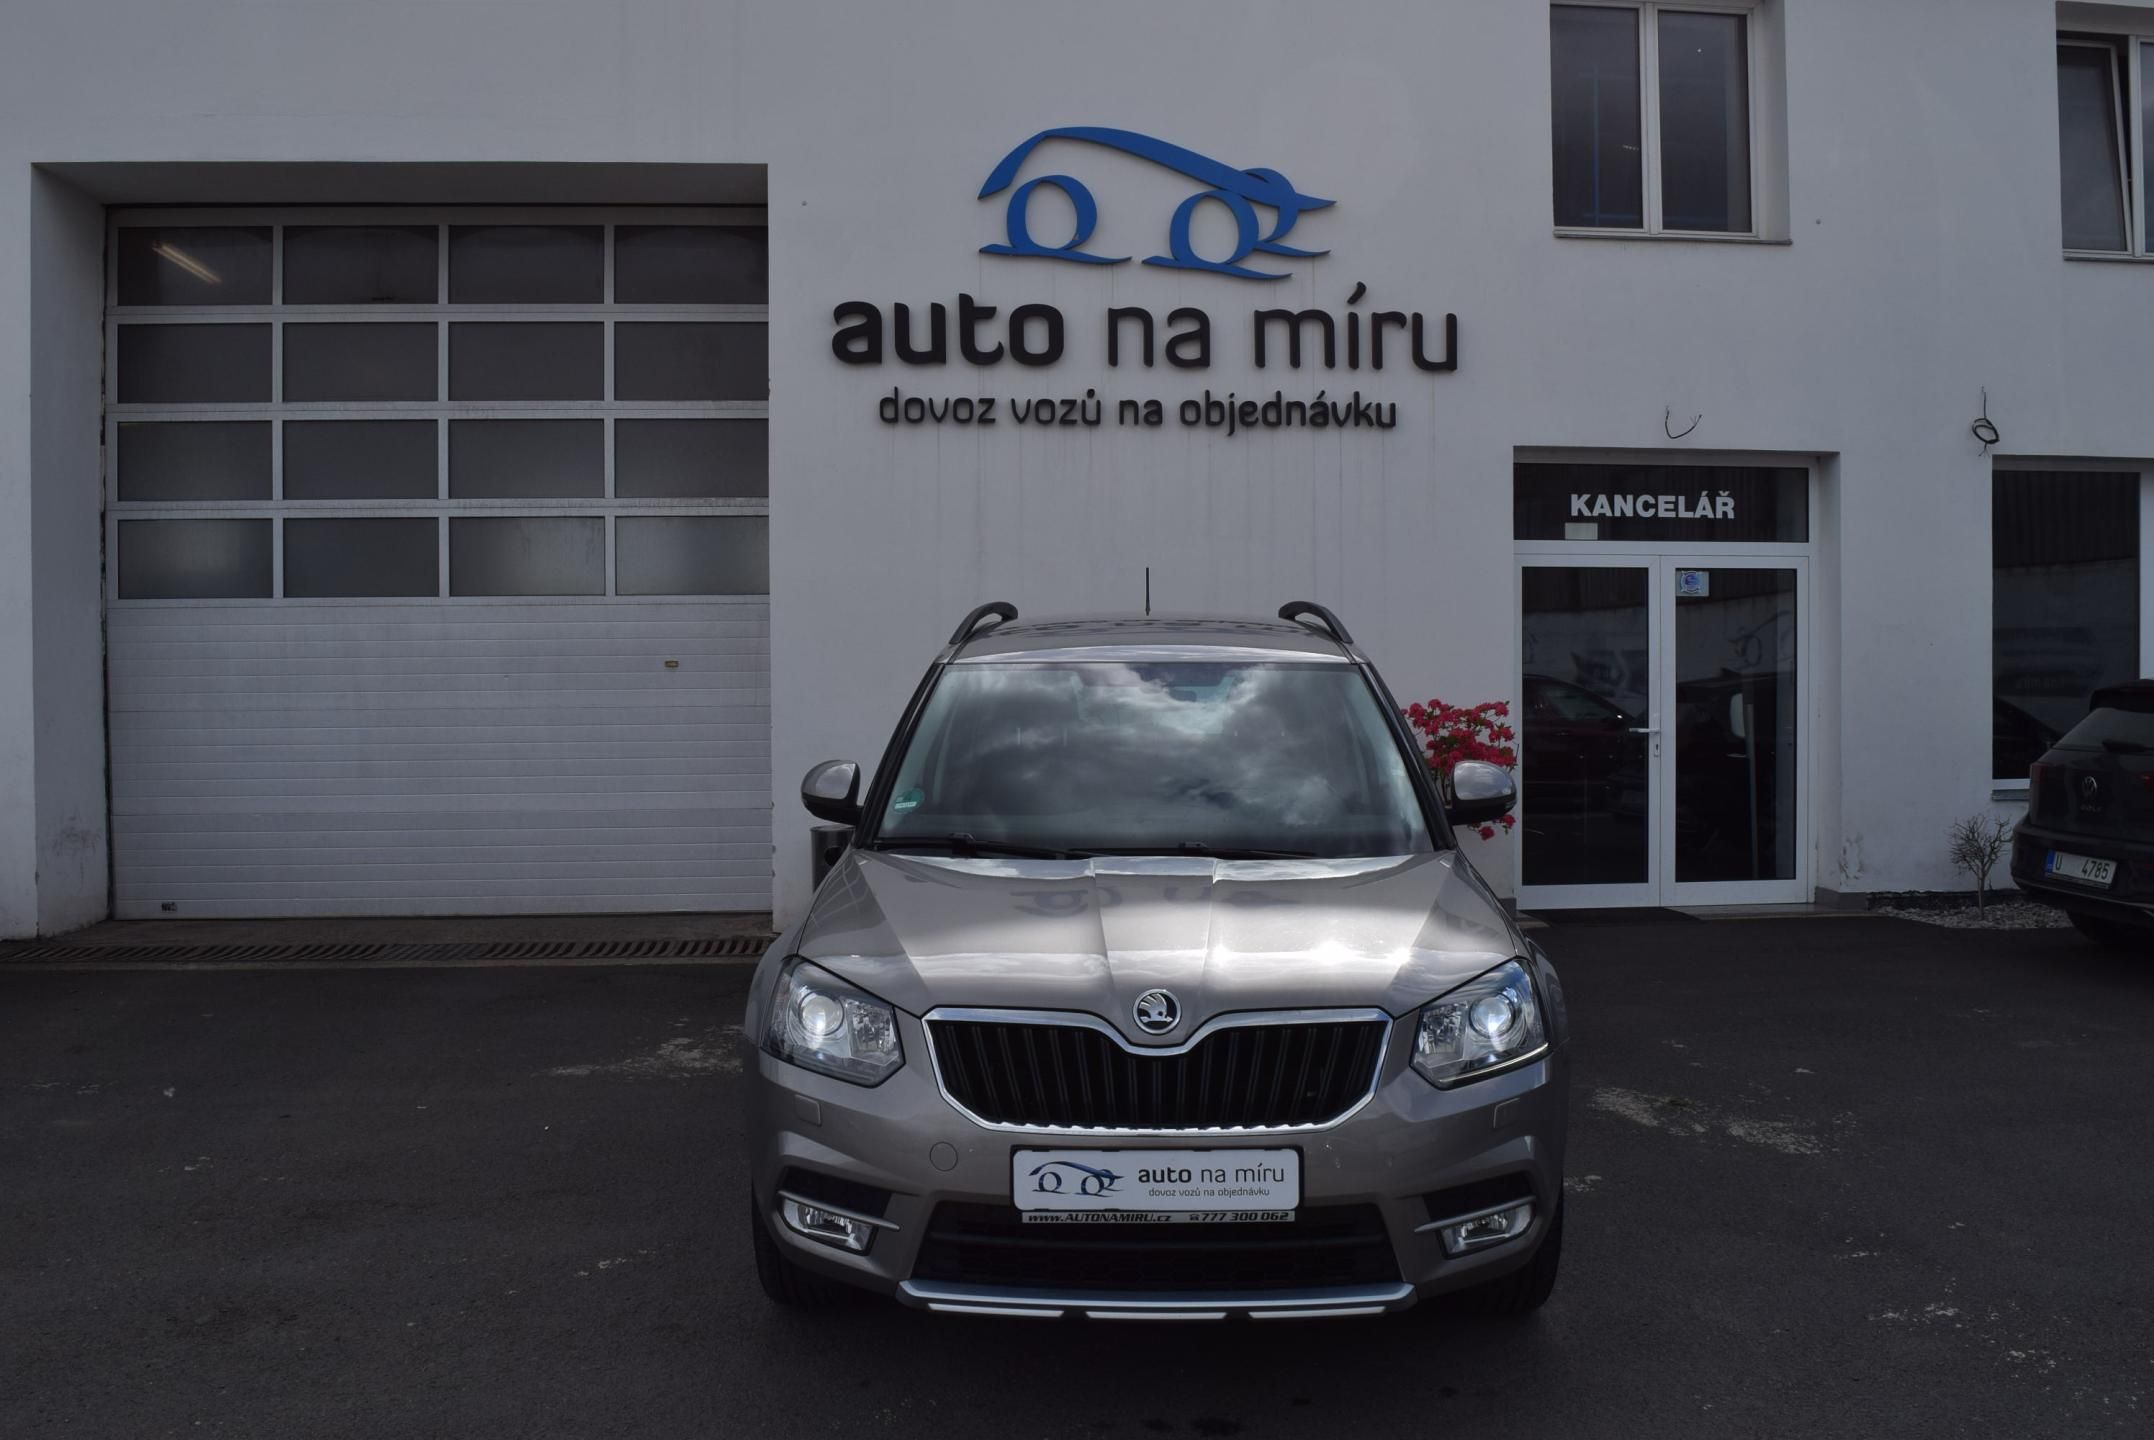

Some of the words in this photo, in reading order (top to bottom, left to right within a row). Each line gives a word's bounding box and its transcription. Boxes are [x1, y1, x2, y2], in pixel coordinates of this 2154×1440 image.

[832, 293, 1065, 368] auto
[1107, 306, 1211, 370] na
[1254, 281, 1458, 371] míru
[879, 387, 996, 426] dovoz
[1011, 388, 1101, 427] vozů
[1118, 399, 1163, 427] na
[1179, 389, 1397, 436] objednávku
[1570, 490, 1736, 519] KANCELÁŘ
[2082, 859, 2110, 880] 4785
[1138, 1166, 1192, 1183] auto
[1200, 1168, 1226, 1183] na
[1235, 1162, 1285, 1183] míru
[1148, 1187, 1177, 1197] dovoz
[1178, 1186, 1201, 1197] vozů
[1203, 1189, 1215, 1197] na
[1217, 1186, 1270, 1199] objednávku
[1201, 1212, 1227, 1222] 777
[1229, 1212, 1260, 1222] 300
[1261, 1211, 1289, 1221] 062
